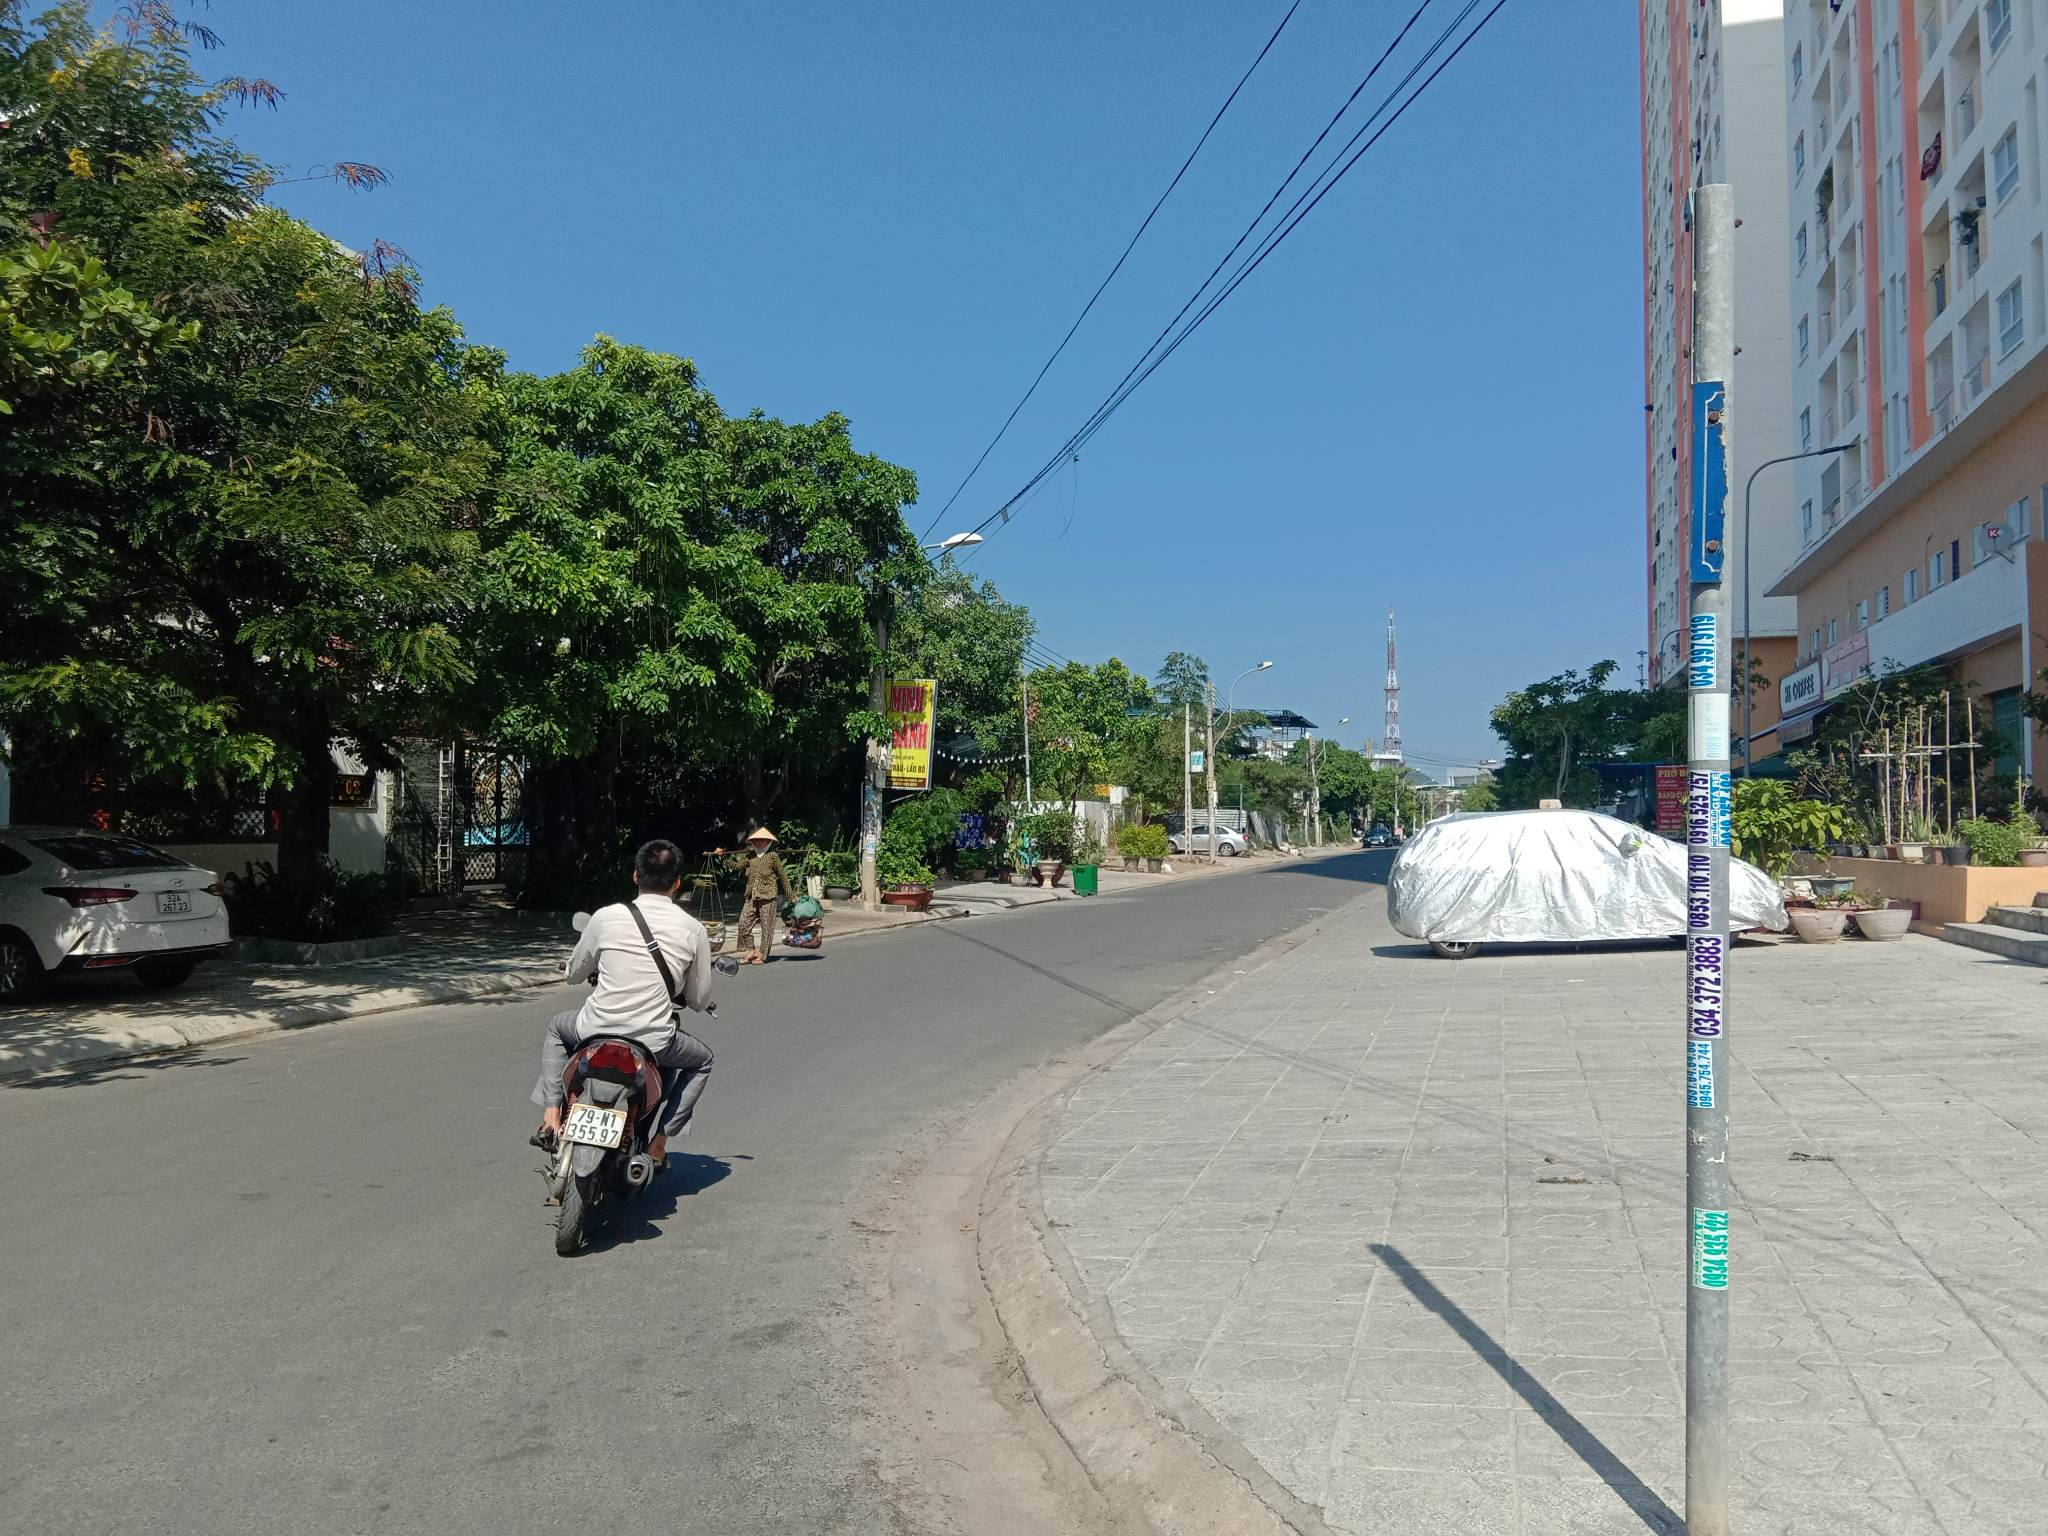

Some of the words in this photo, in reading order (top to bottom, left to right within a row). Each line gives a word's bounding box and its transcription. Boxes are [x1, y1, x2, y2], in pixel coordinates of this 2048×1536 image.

[1690, 615, 1715, 687] 034.997.9119
[1689, 772, 1709, 844] 0916.525.757
[1689, 855, 1710, 928] 0853.110.110
[1693, 937, 1721, 1037] 034.372.3883
[1698, 1043, 1713, 1108] 0945.754.744
[568, 1123, 619, 1145] 355.97
[578, 1108, 617, 1128] 79-N1
